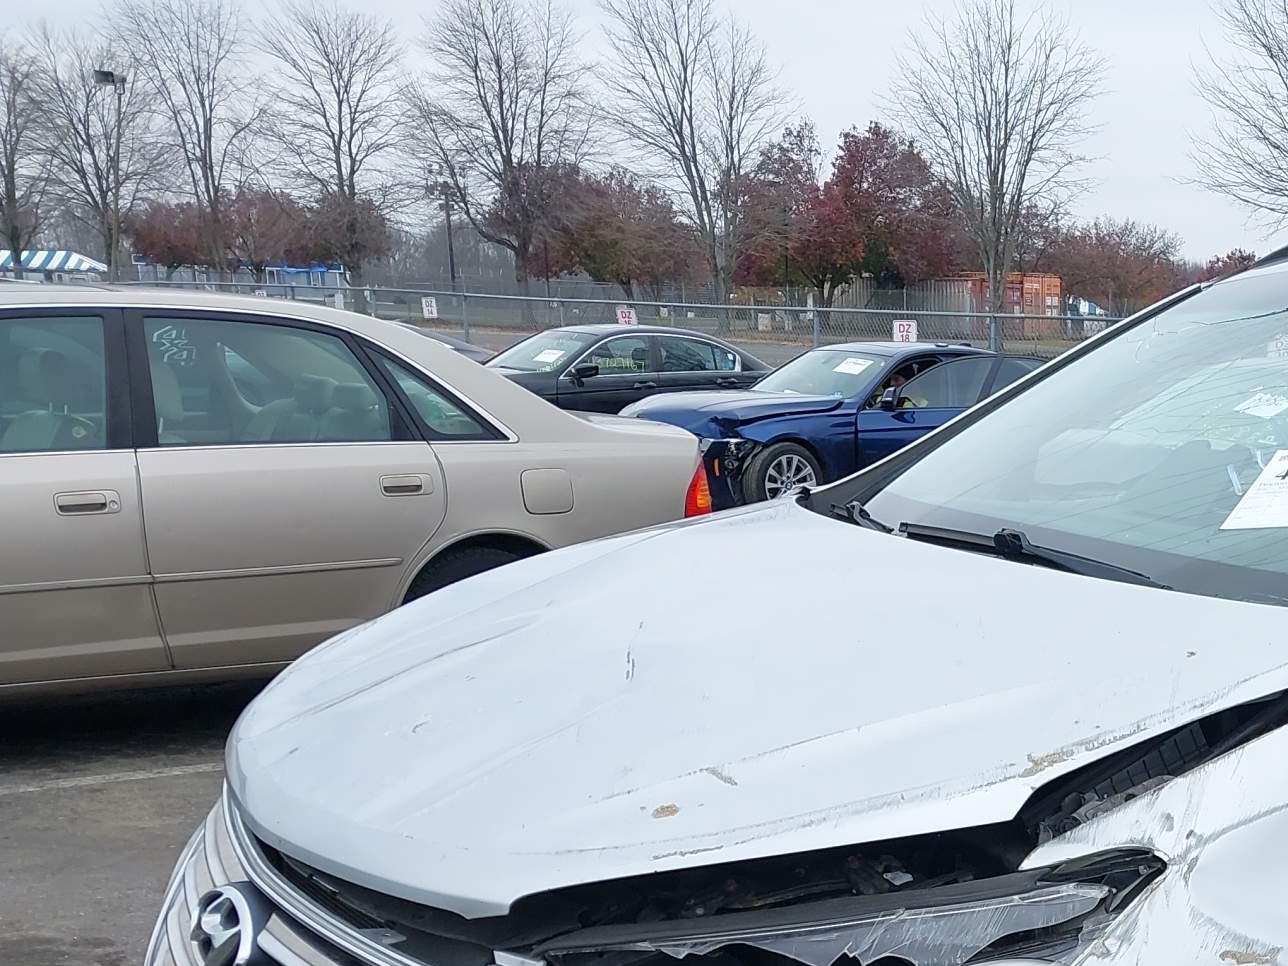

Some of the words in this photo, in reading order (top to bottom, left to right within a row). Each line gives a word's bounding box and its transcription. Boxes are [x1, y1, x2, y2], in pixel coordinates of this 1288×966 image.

[620, 310, 632, 319] DZ
[898, 323, 912, 334] DZ
[901, 334, 910, 342] 18
